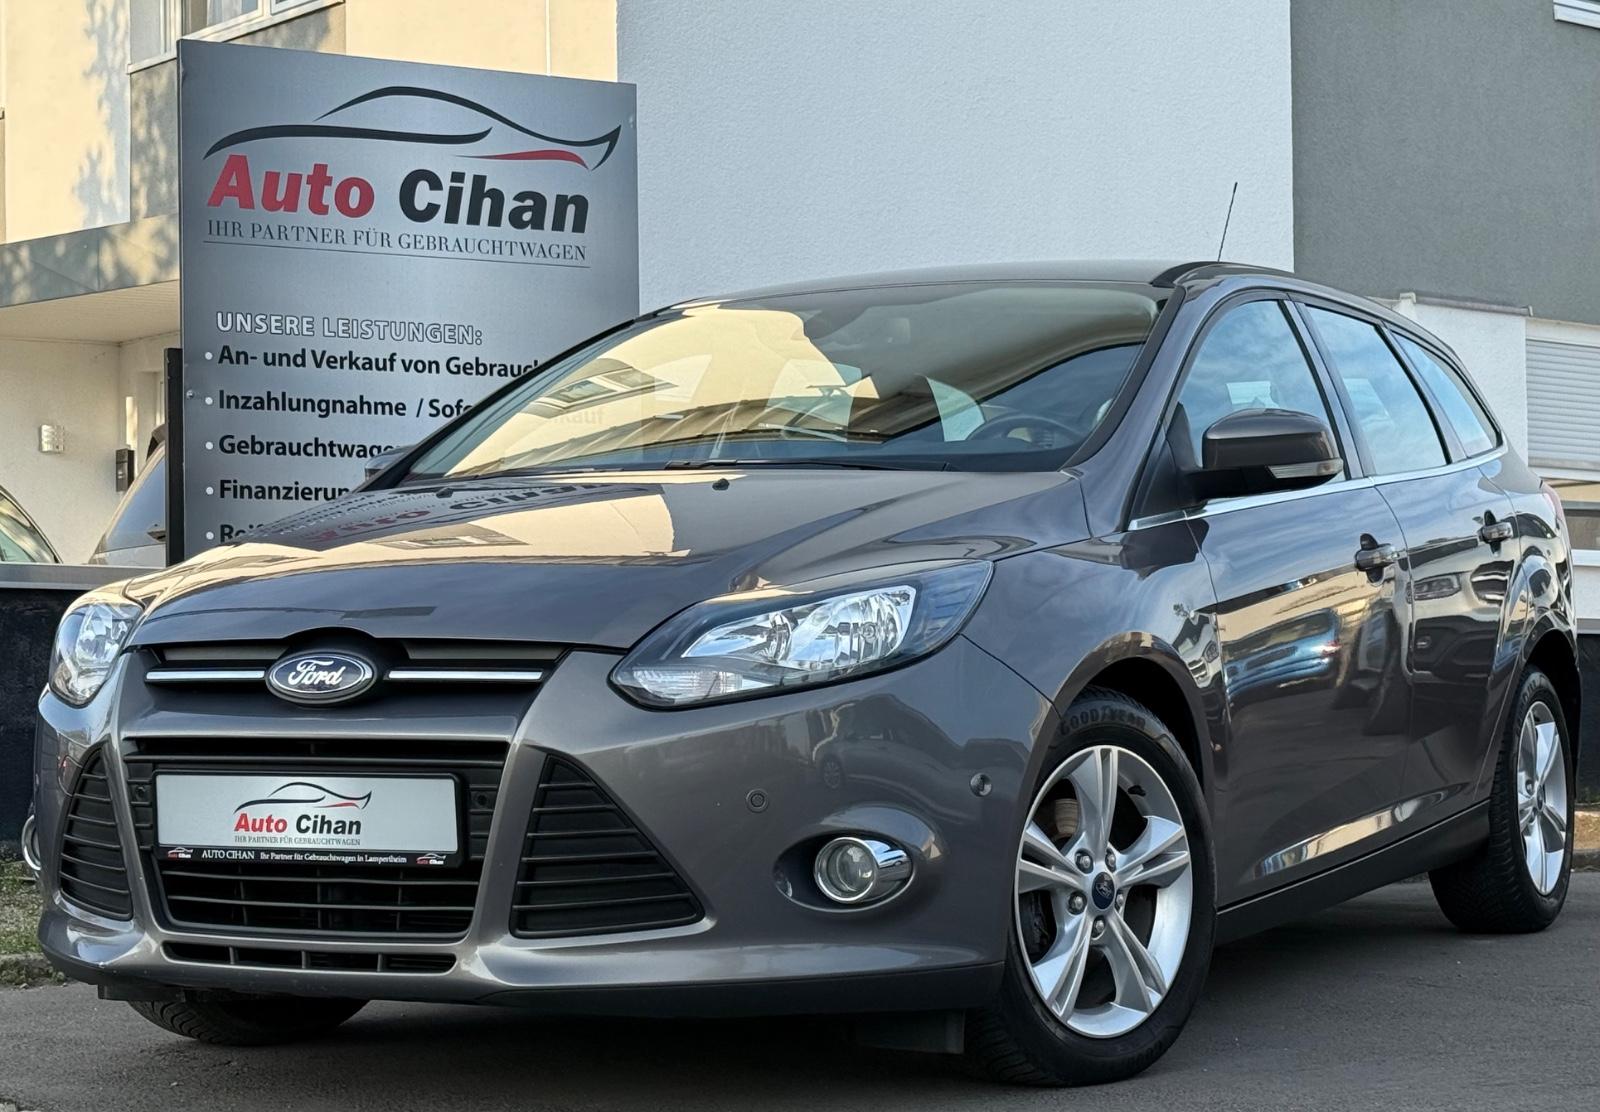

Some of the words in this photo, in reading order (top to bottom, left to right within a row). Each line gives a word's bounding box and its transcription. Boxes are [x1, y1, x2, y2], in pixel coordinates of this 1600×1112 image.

[207, 153, 375, 219] Auto
[399, 168, 589, 233] Cihan
[208, 219, 244, 239] IHR
[251, 223, 345, 245] PARTNER
[353, 227, 392, 249] FÜR
[398, 233, 587, 261] GEBRAUCHTWAGEN
[216, 311, 315, 337] UNSERE
[323, 317, 483, 346] LEISTUNGEN:
[218, 345, 258, 367] An-
[263, 347, 306, 369] und
[311, 349, 397, 373] Verkauf
[401, 357, 440, 375] von
[445, 356, 539, 379] Gebrauc
[218, 389, 407, 418] Inzahlungnahme
[428, 398, 473, 418] Sof
[218, 435, 401, 459] Gebrauchtwag
[288, 659, 346, 685] Ford
[234, 813, 288, 833] Auto
[296, 814, 362, 835] Cihan
[248, 836, 278, 844] PARTNER
[201, 850, 225, 859] AUTO
[226, 850, 255, 859] CIHAN
[271, 852, 293, 860] Partner
